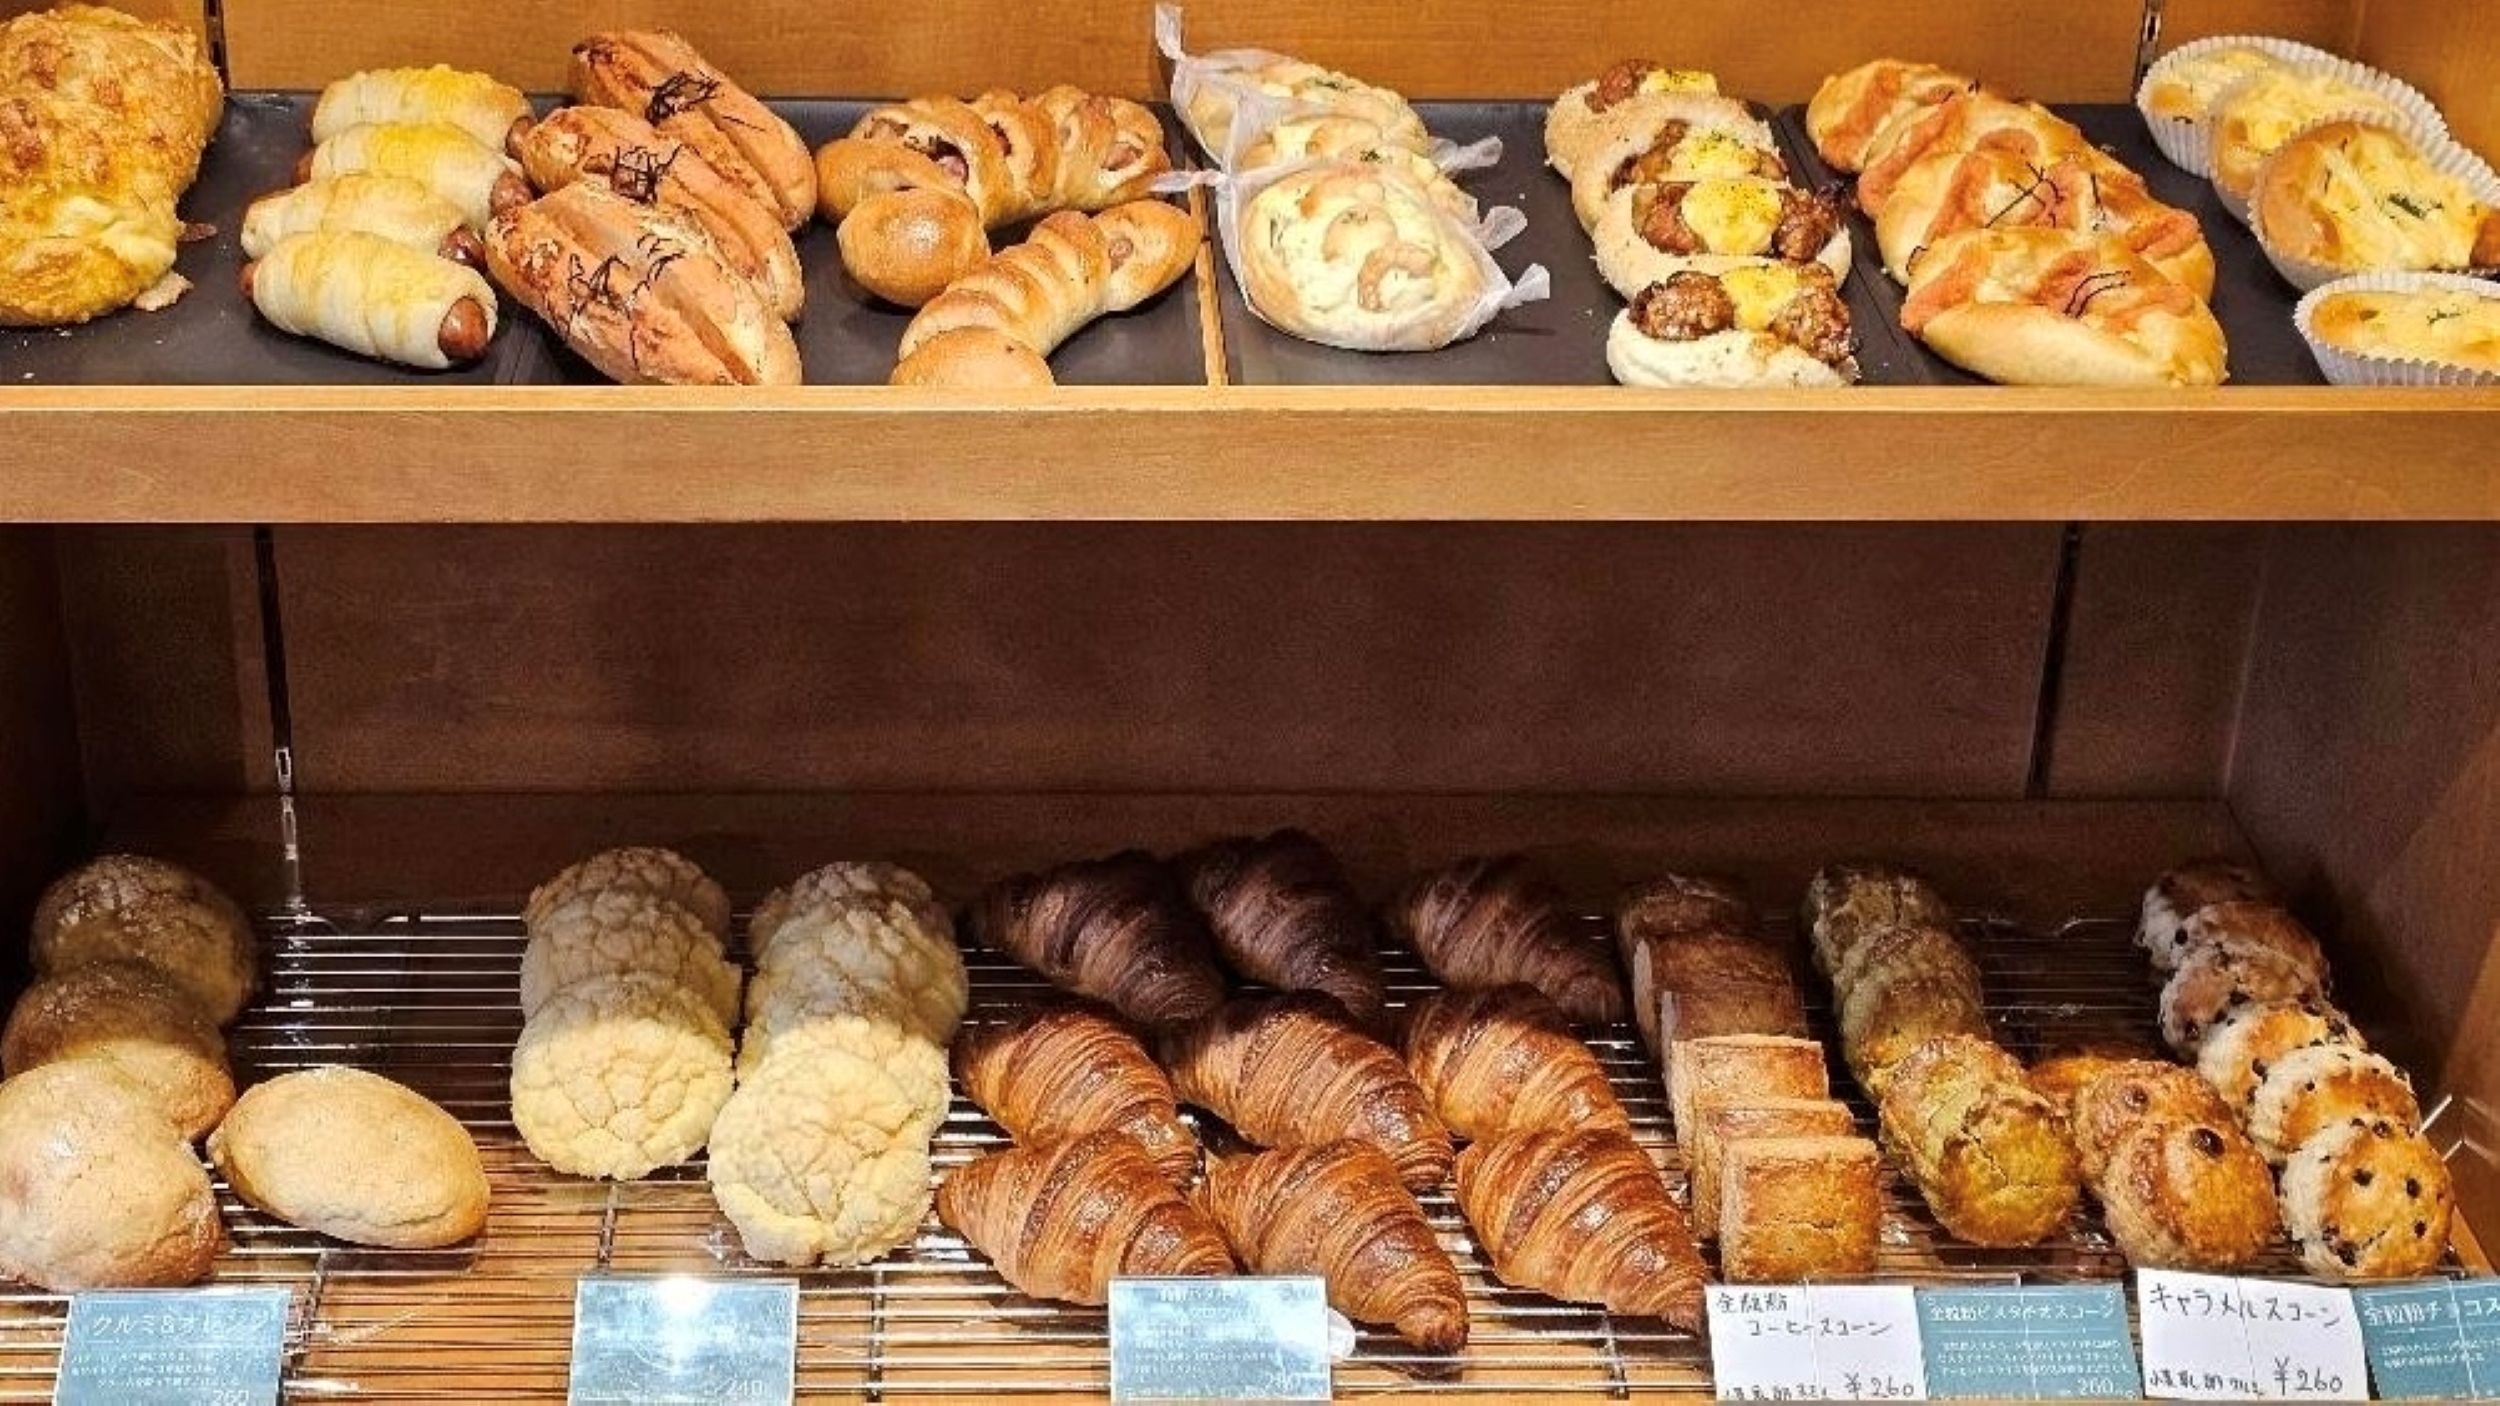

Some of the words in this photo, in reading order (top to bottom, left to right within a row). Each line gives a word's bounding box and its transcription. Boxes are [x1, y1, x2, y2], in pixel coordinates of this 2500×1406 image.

[2149, 1281, 2342, 1329] キャラメルスコーン
[1747, 1317, 1893, 1338] コーヒースコーン
